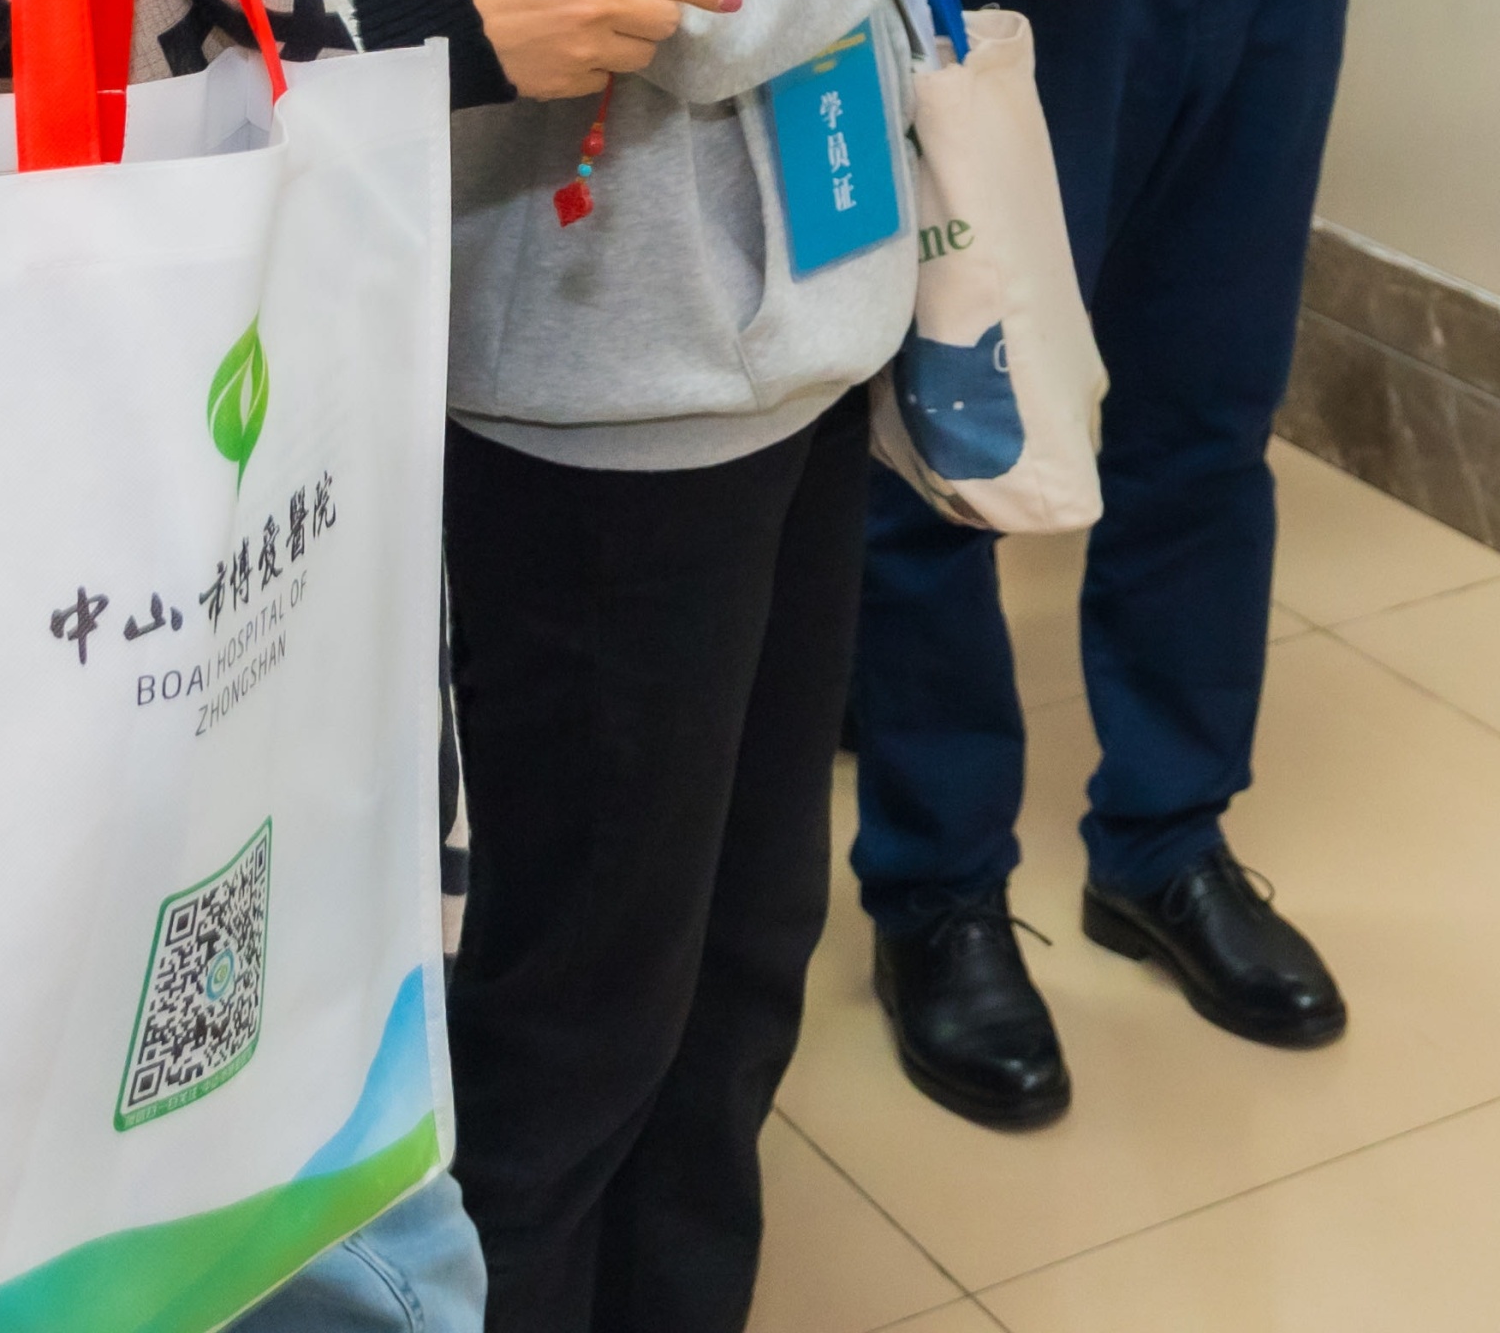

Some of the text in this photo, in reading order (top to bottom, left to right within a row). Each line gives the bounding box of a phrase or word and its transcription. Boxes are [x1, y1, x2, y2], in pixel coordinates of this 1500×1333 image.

[819, 91, 856, 212] 学员证
[137, 570, 308, 705] BOAI HOSPITAL OF
[195, 631, 286, 736] ZHONGSHAN
